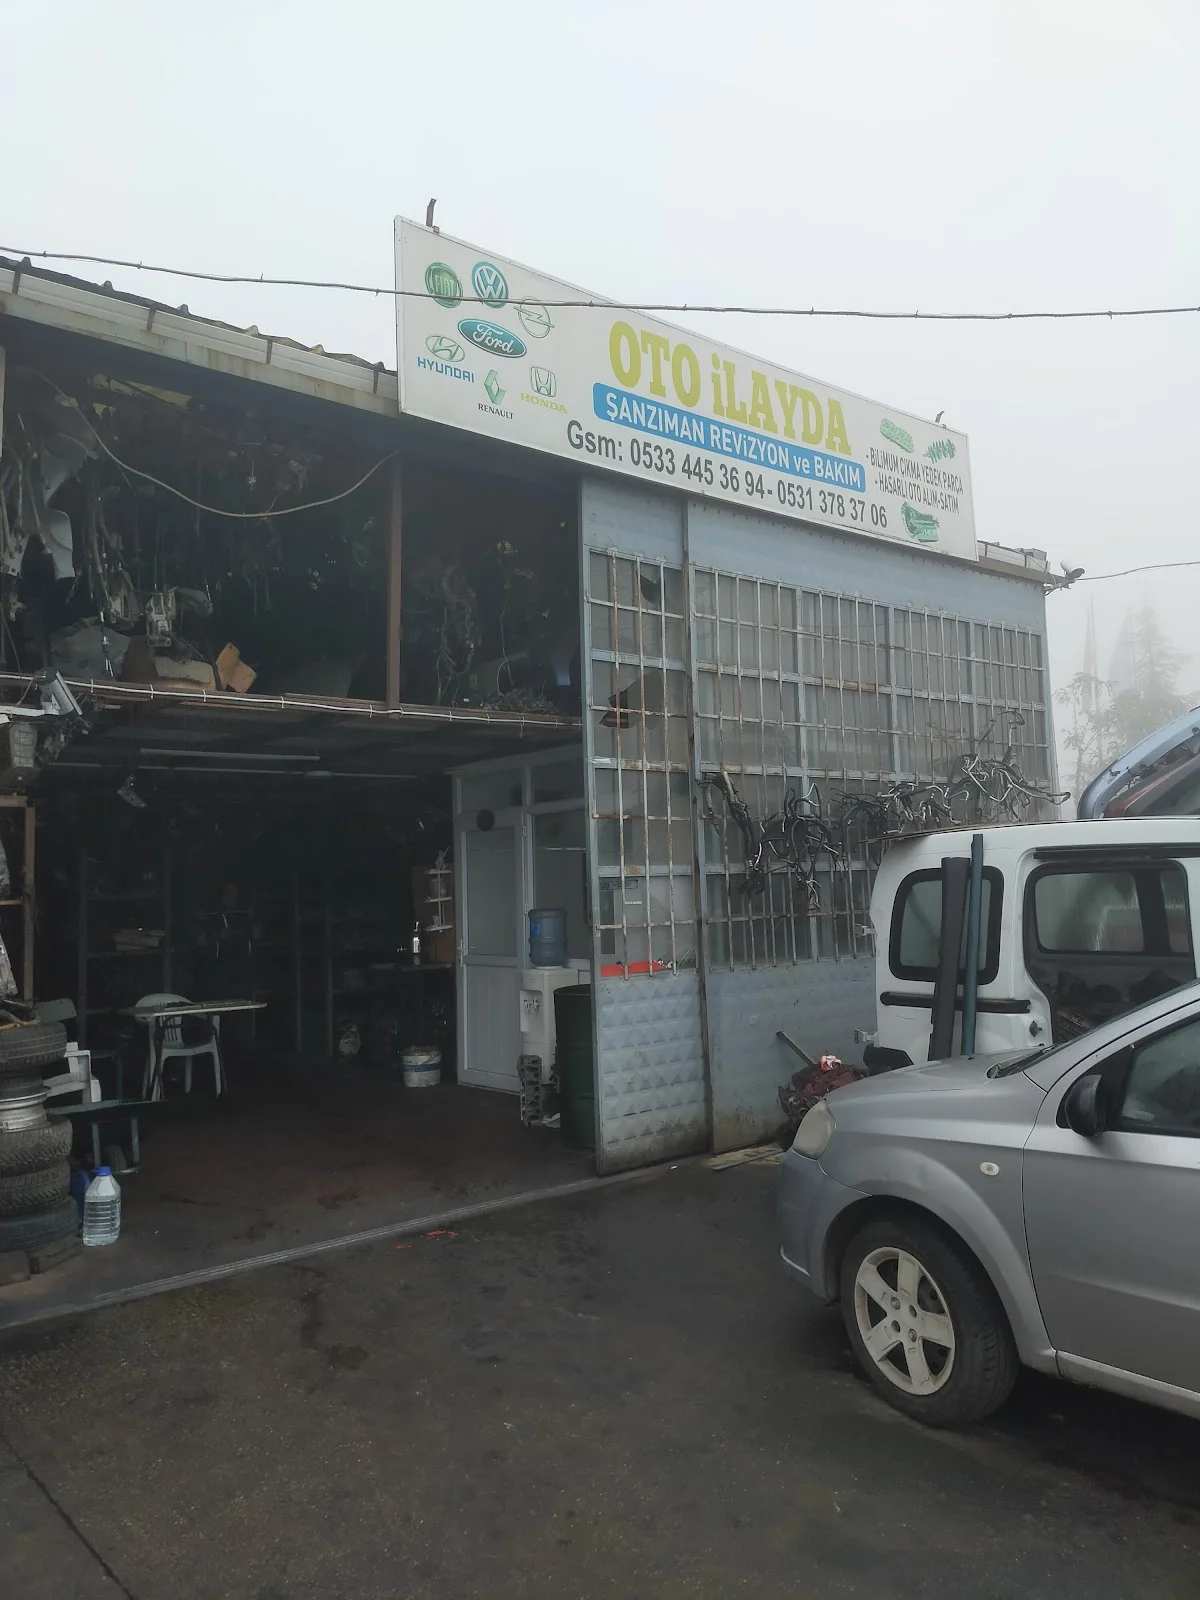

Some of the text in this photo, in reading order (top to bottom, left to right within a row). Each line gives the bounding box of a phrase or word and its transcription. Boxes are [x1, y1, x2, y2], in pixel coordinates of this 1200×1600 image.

[434, 274, 455, 298] FIAT
[473, 323, 515, 354] Ford
[416, 356, 475, 384] HYUNDAI
[608, 320, 702, 408] OTO
[477, 402, 515, 420] RENAULT
[519, 392, 569, 415] HONDA
[606, 392, 705, 445] ŞANZIMAN
[793, 454, 811, 475] ve
[813, 455, 862, 489] BAKIM
[566, 419, 623, 462] Gsm:
[630, 438, 676, 475] 0533
[681, 453, 714, 485] 445
[719, 463, 740, 493] 36
[777, 479, 813, 511] 0531
[819, 489, 846, 517] 378
[849, 497, 866, 523] 37
[870, 503, 888, 528] 06
[879, 472, 908, 498] HASARLI
[908, 481, 922, 503] OTO
[921, 464, 942, 488] YEDEK
[942, 471, 964, 495] PARÇA
